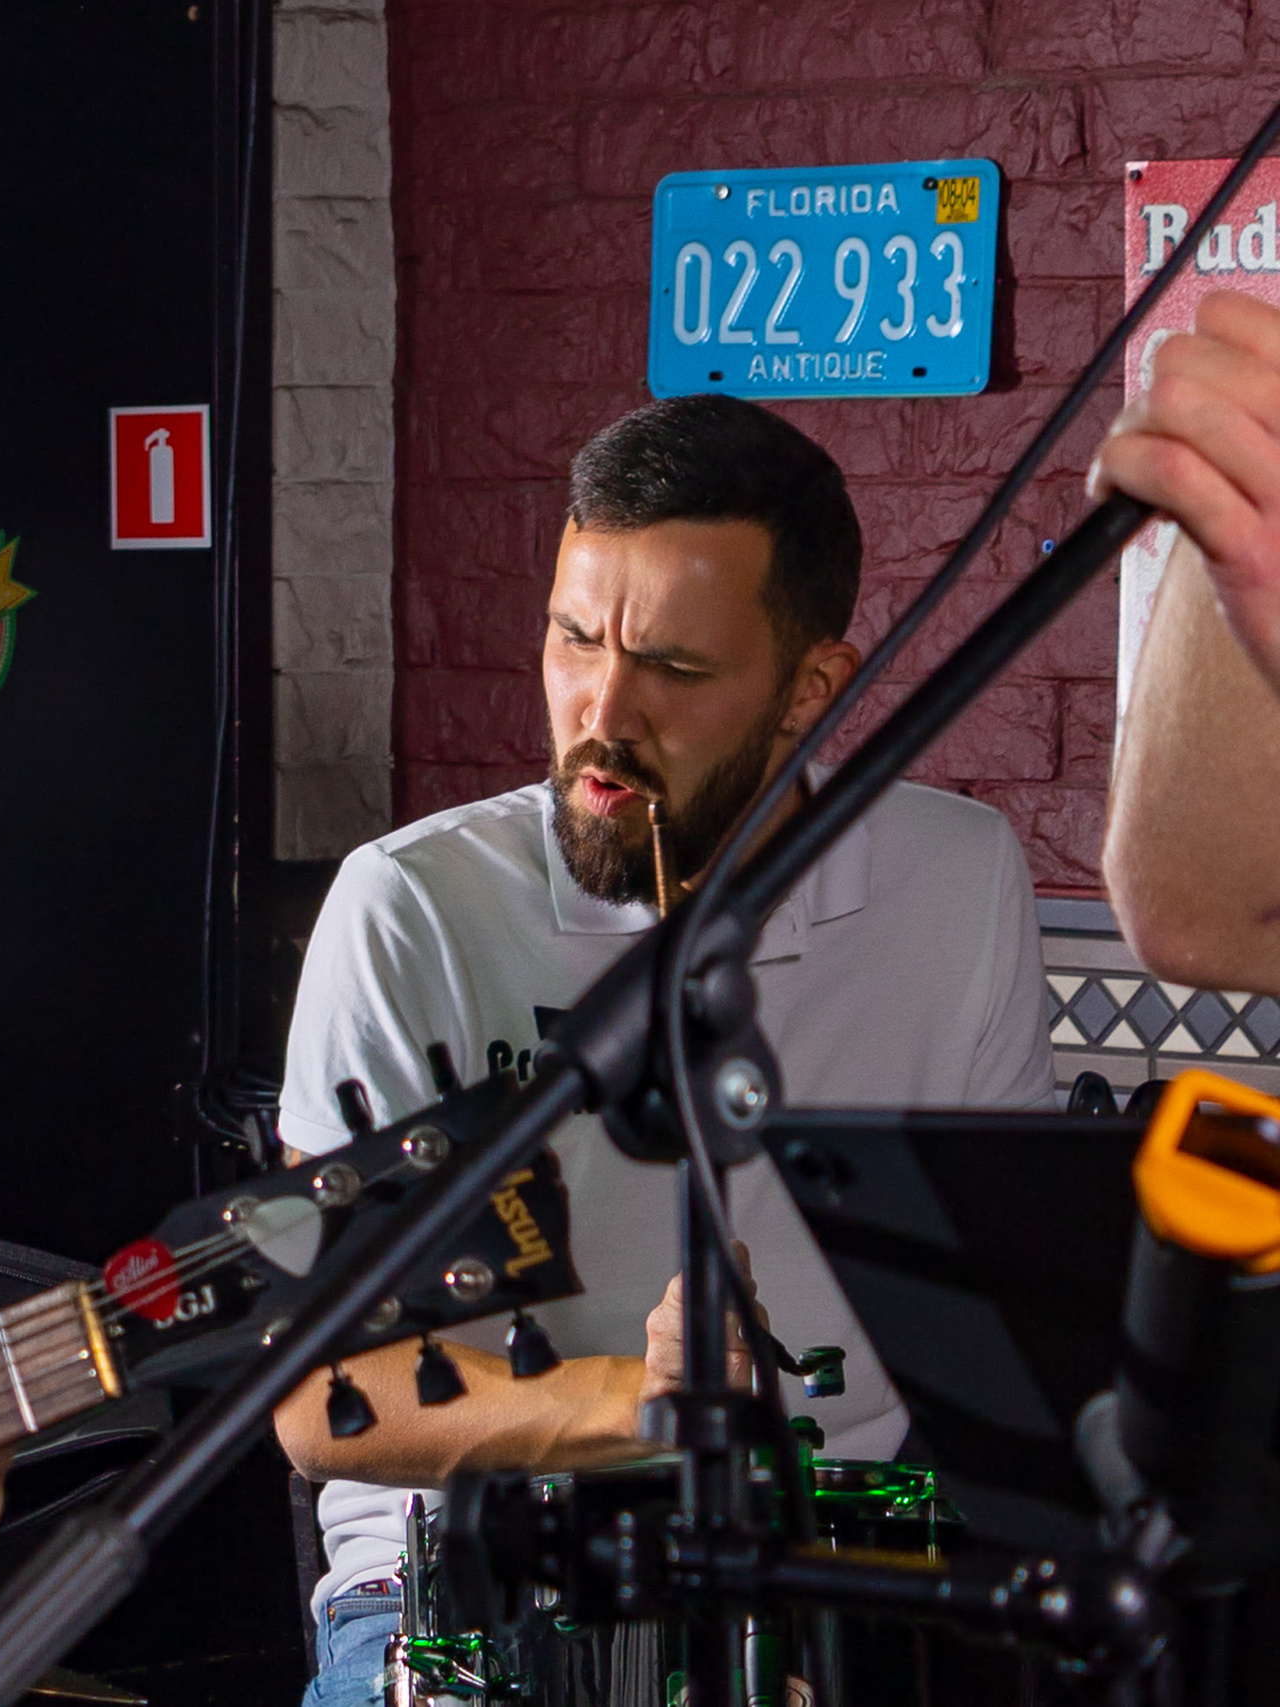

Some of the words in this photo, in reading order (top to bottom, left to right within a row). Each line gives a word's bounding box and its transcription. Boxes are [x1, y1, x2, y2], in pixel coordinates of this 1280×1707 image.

[747, 183, 900, 218] FLORIDA
[673, 239, 803, 345] 022
[834, 231, 963, 344] 933
[747, 351, 887, 381] ANTIQUE
